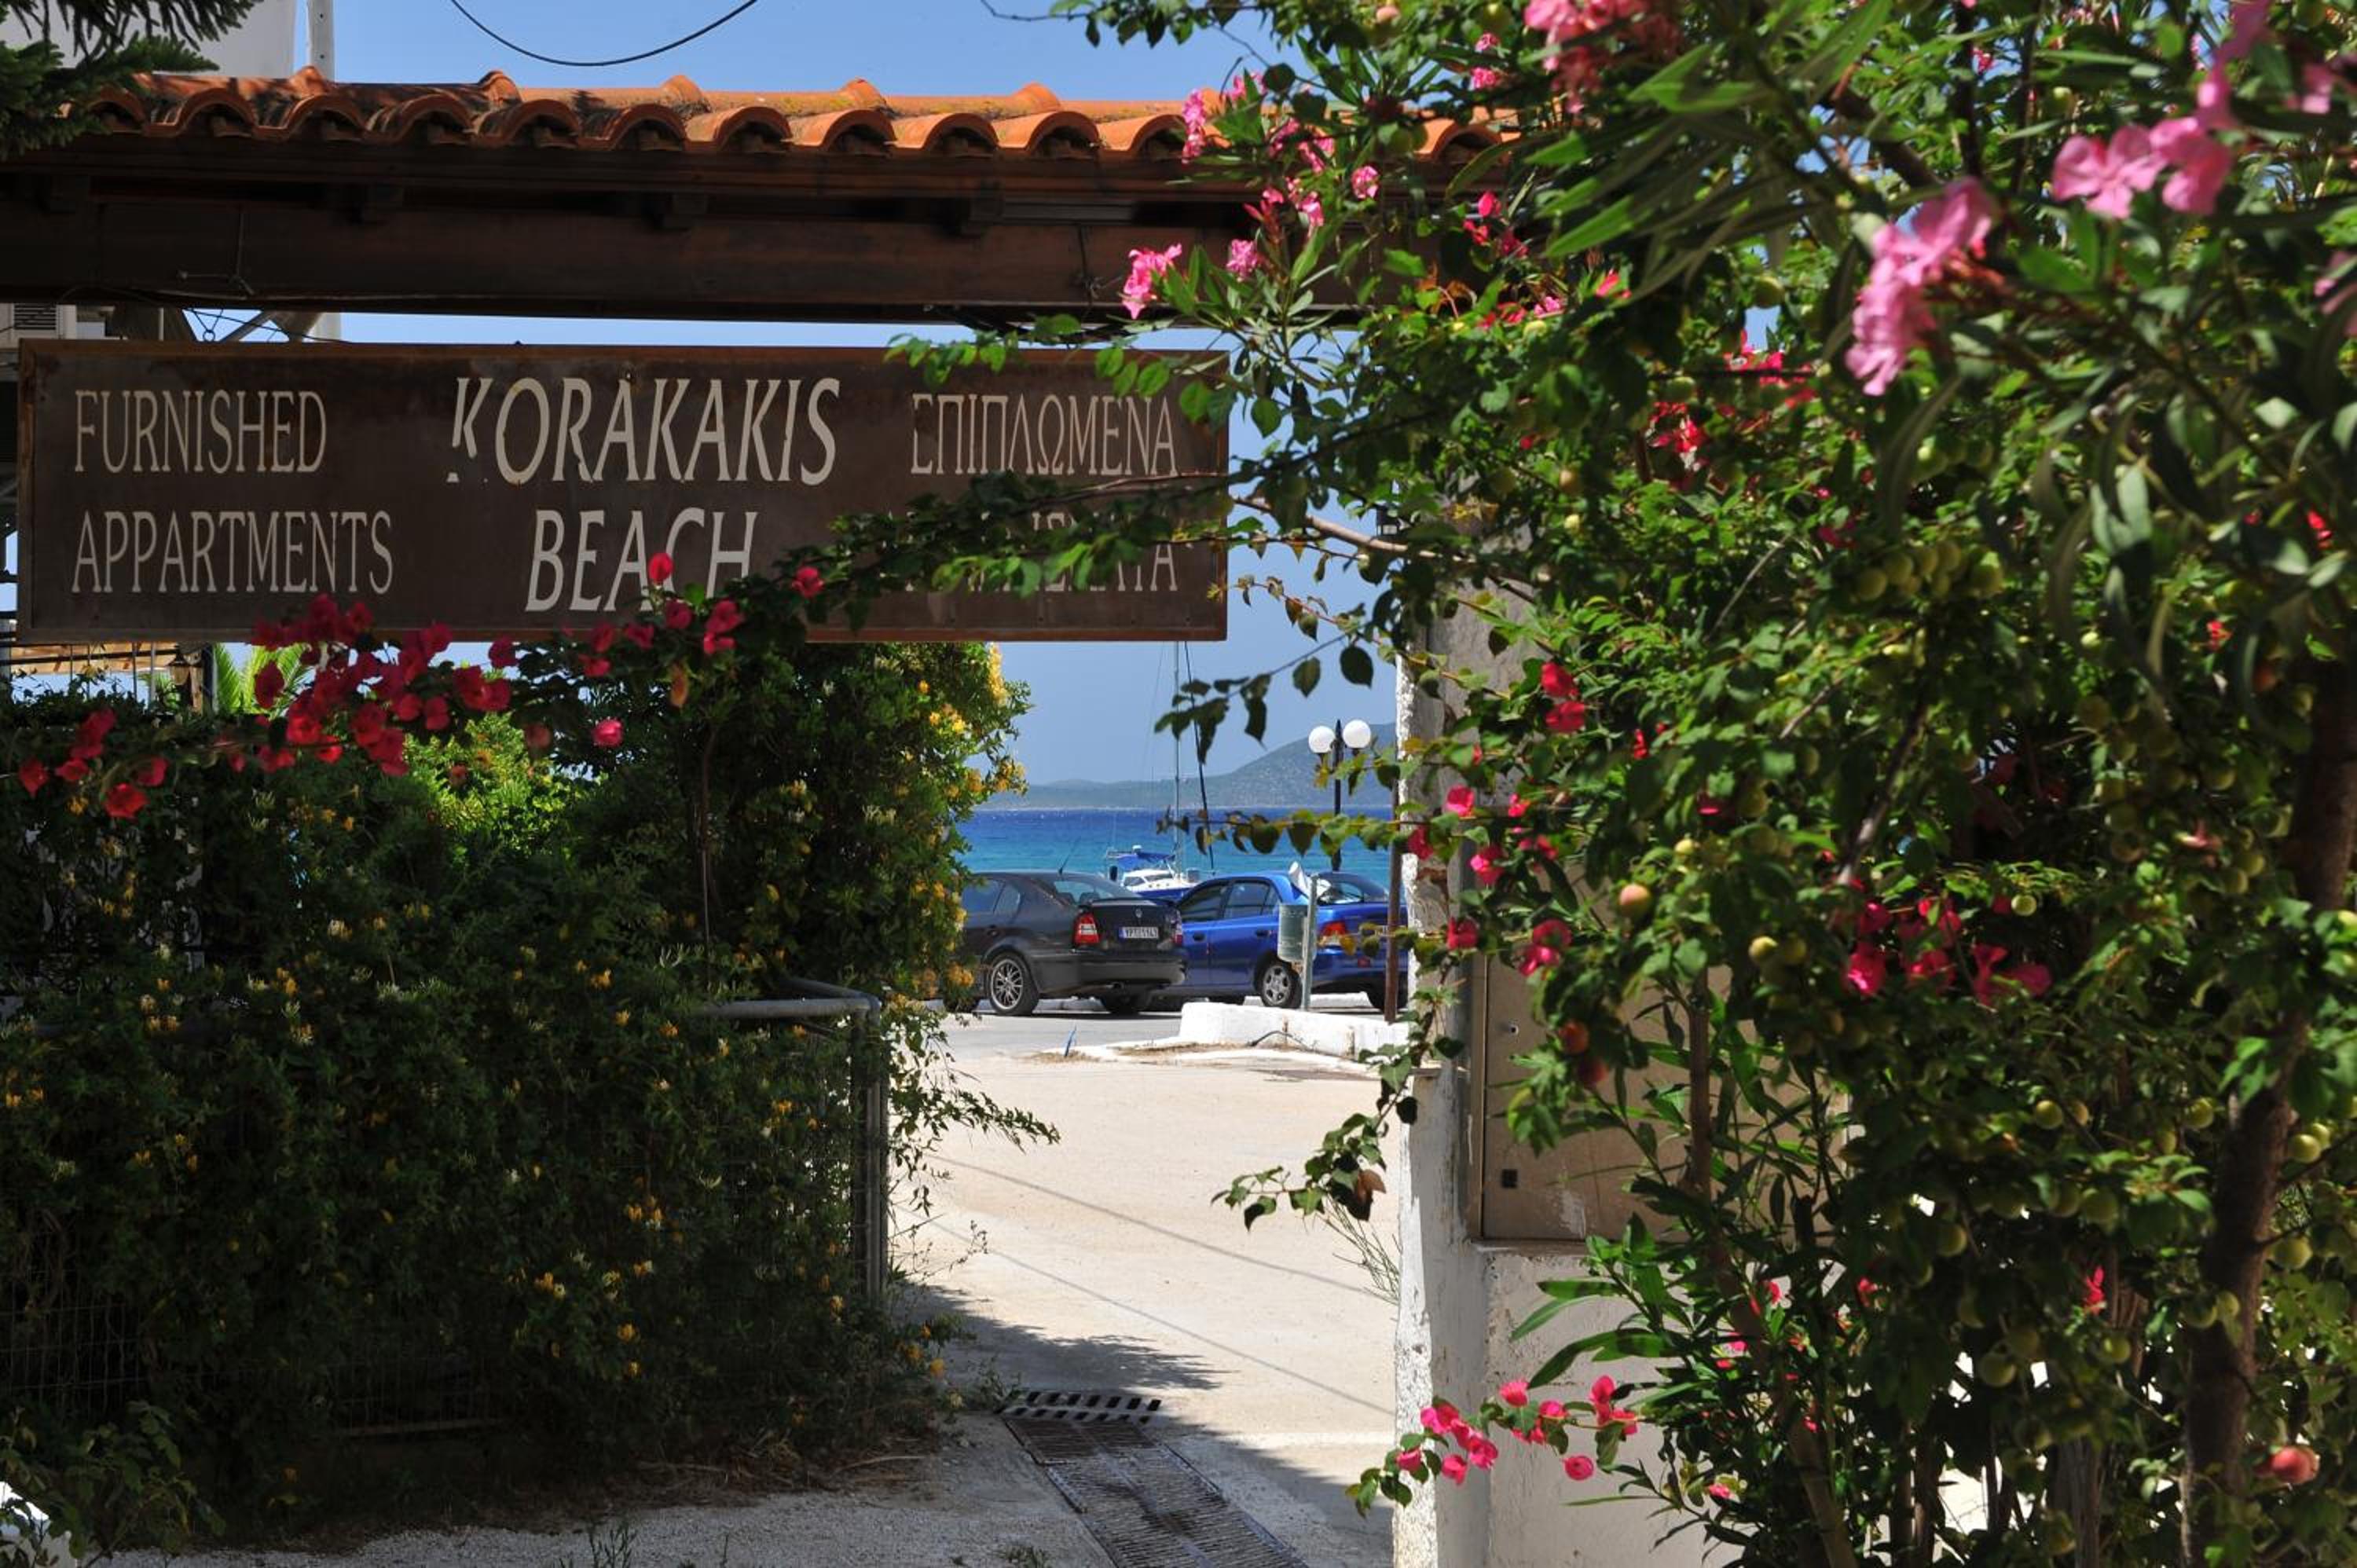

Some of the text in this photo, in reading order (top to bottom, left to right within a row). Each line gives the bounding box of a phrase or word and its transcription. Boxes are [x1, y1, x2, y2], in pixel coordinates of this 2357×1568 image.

[74, 390, 327, 474] FURNISHED
[447, 378, 840, 485] KORAKAKIS
[911, 393, 1178, 476] ΕΠΙΠΛΩΜΕΝΑ
[71, 511, 394, 595] APPARTMENTS
[524, 507, 759, 612] BEACH
